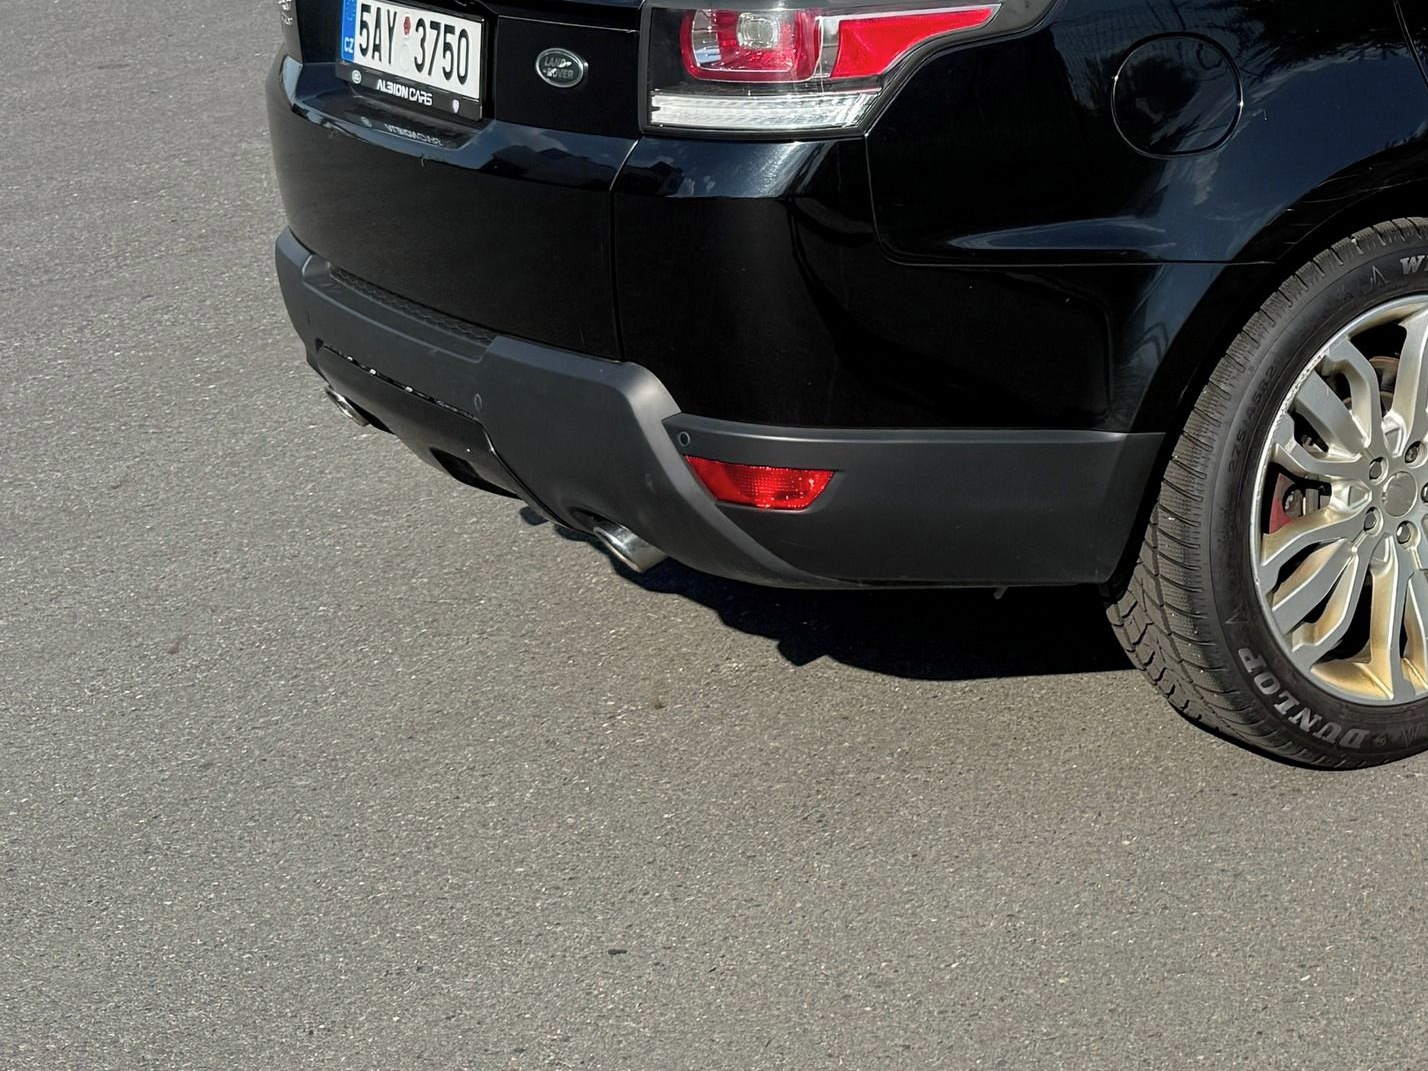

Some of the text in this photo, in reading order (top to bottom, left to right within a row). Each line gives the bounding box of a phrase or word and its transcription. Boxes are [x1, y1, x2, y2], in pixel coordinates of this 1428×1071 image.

[344, 36, 354, 54] CZ
[359, 3, 470, 85] 5AY 3750
[376, 78, 433, 106] ALBION CARS
[1237, 647, 1371, 749] DUNLOP
